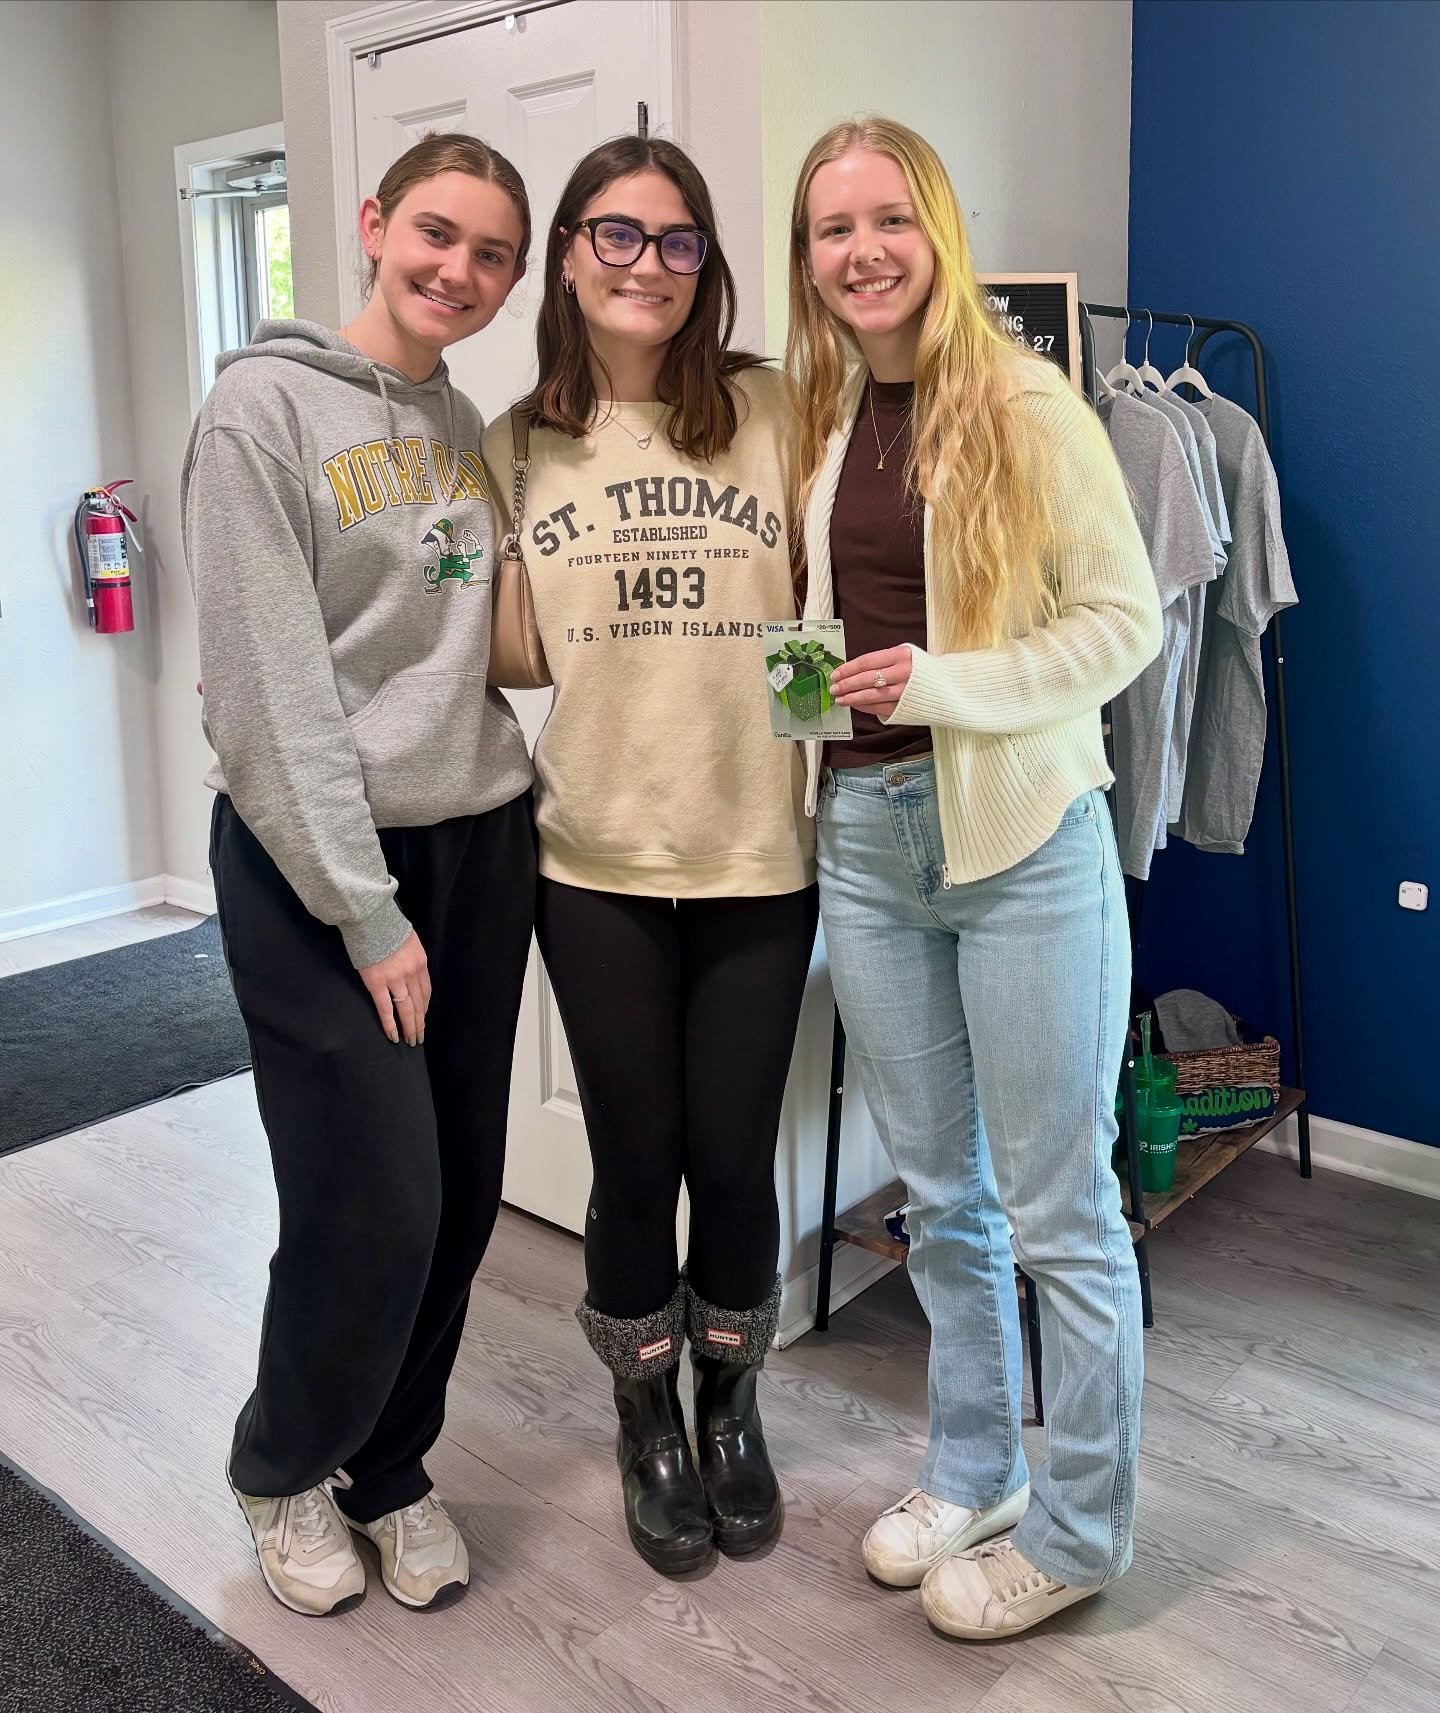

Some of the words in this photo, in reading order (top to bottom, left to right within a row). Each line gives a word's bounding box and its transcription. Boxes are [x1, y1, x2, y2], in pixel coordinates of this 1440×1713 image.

[986, 296, 1010, 312] OW
[1000, 316, 1024, 332] NG
[1033, 335, 1055, 352] 27
[322, 436, 437, 533] NOTRE
[532, 502, 595, 556] ST.
[605, 476, 782, 549] THOMAS
[612, 525, 708, 544] ESTABLISHED
[567, 552, 640, 567] FOURTEEN
[646, 549, 698, 561] NINETY
[704, 548, 750, 559] THREE
[614, 566, 706, 612] 1493
[567, 627, 600, 643] U.S.
[609, 620, 673, 639] VIRGIN
[682, 621, 764, 638] ISLANDS
[766, 625, 785, 633] VISA
[1182, 1087, 1272, 1116] adition
[1149, 1143, 1171, 1152] IRISH
[709, 1333, 739, 1343] HUNTER
[641, 1342, 669, 1357] HUNTER
